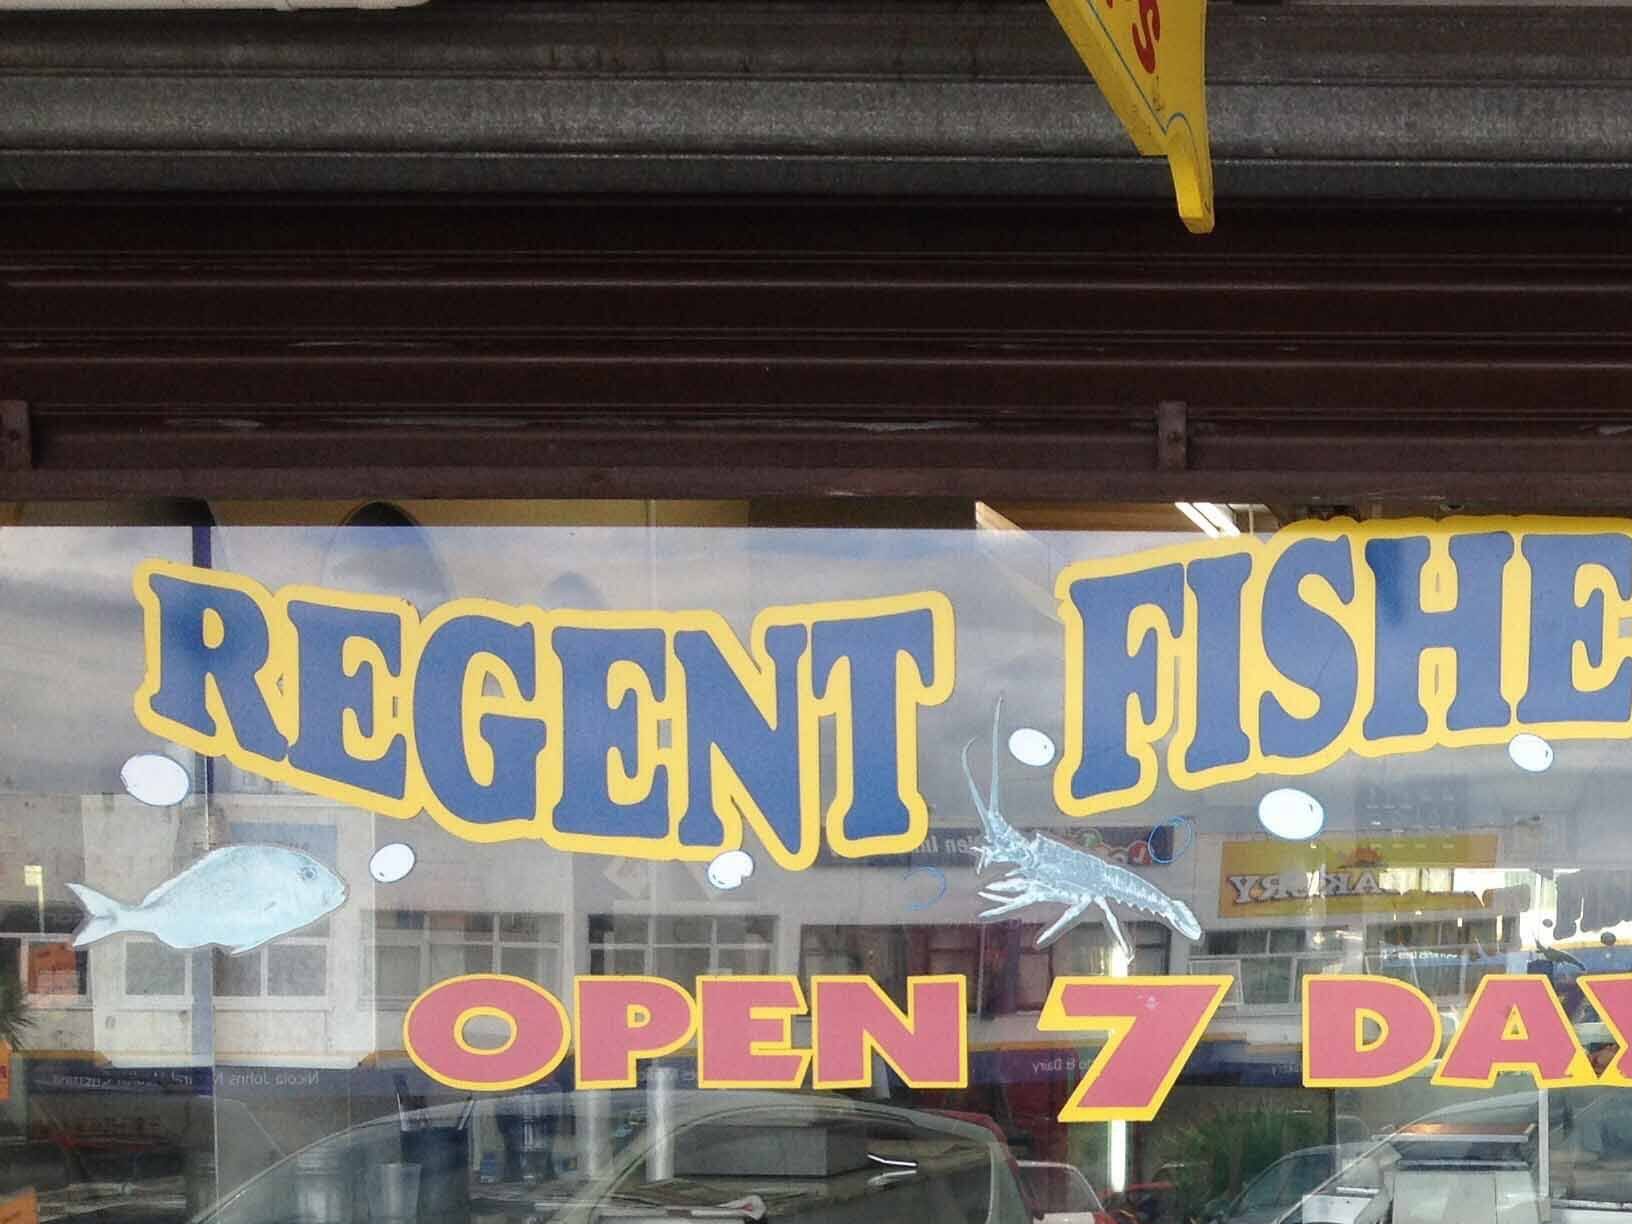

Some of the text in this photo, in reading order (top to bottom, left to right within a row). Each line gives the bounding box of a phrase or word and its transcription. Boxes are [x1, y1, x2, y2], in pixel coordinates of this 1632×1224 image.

[133, 557, 957, 872] REGENT
[404, 974, 967, 1091] OPEN
[1037, 974, 1234, 1123] 7
